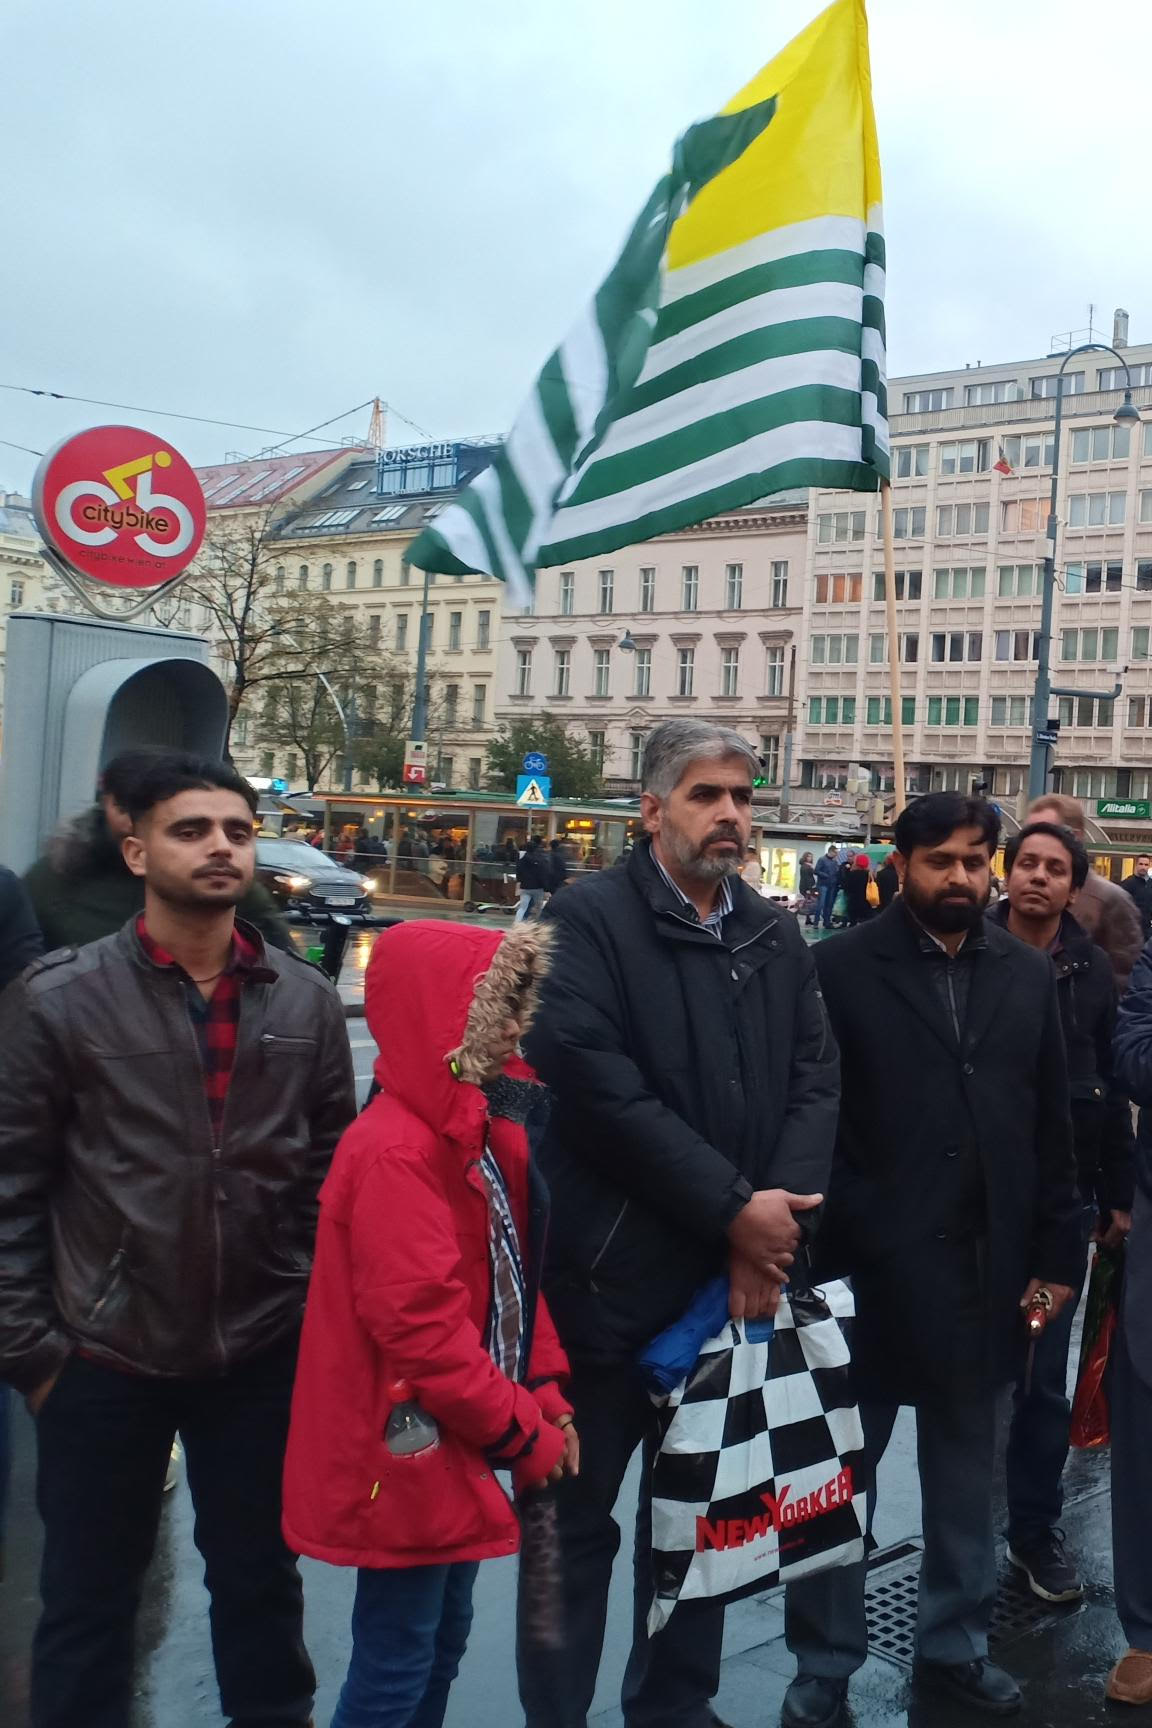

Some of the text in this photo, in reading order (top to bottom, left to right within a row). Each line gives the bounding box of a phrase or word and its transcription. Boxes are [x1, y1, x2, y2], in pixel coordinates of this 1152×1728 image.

[375, 443, 455, 464] PORSCHE
[82, 504, 169, 532] citybike
[1100, 803, 1137, 814] Alitalia
